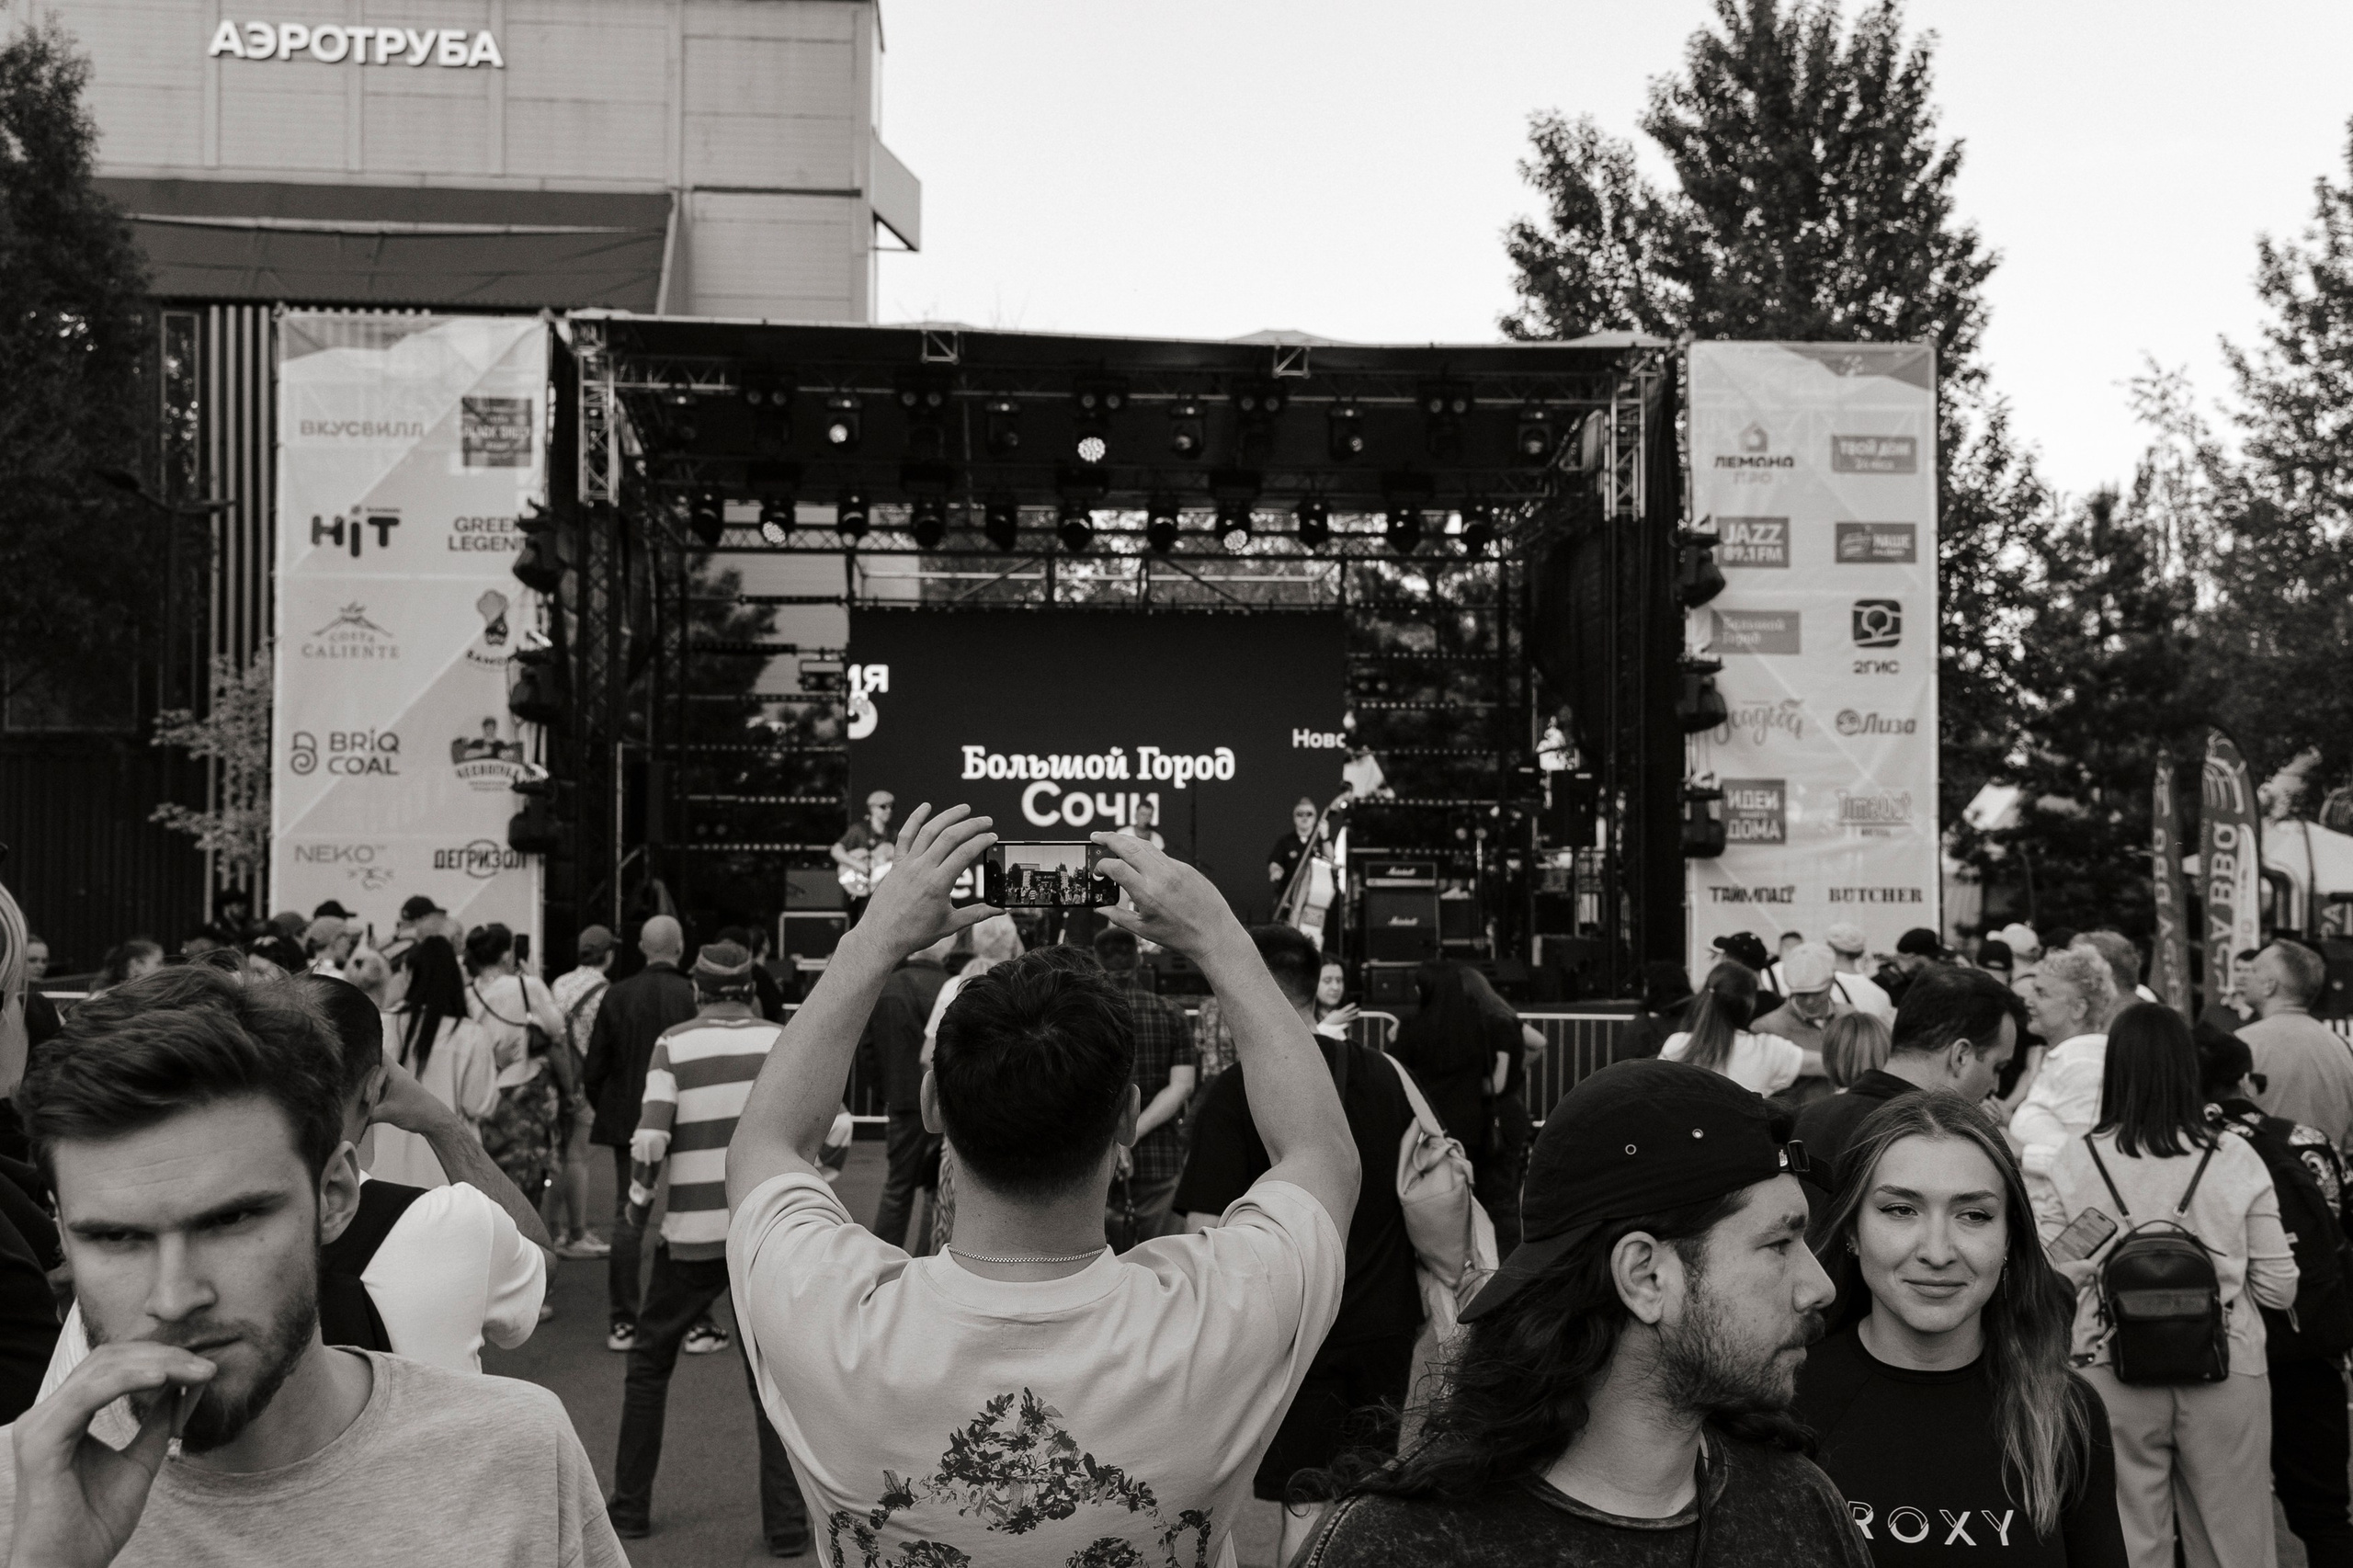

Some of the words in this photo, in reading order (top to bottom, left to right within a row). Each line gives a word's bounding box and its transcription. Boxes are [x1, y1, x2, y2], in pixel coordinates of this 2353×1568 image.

[208, 19, 505, 68] АЭРОТРУБА
[300, 419, 425, 438] ВКУСВИЛЛ
[454, 517, 519, 532] GREE
[1723, 524, 1783, 545] JAZZ
[1853, 660, 1900, 675] 2ГИС
[328, 756, 401, 776] COAL
[961, 744, 1131, 780] Большой
[1136, 745, 1235, 790] Город
[1020, 780, 1160, 827] Сочи
[1726, 819, 1781, 840] ДОМА
[294, 843, 375, 864] NEKO
[1829, 887, 1923, 904] BUTCHER
[1847, 1500, 2014, 1547] ROXY
